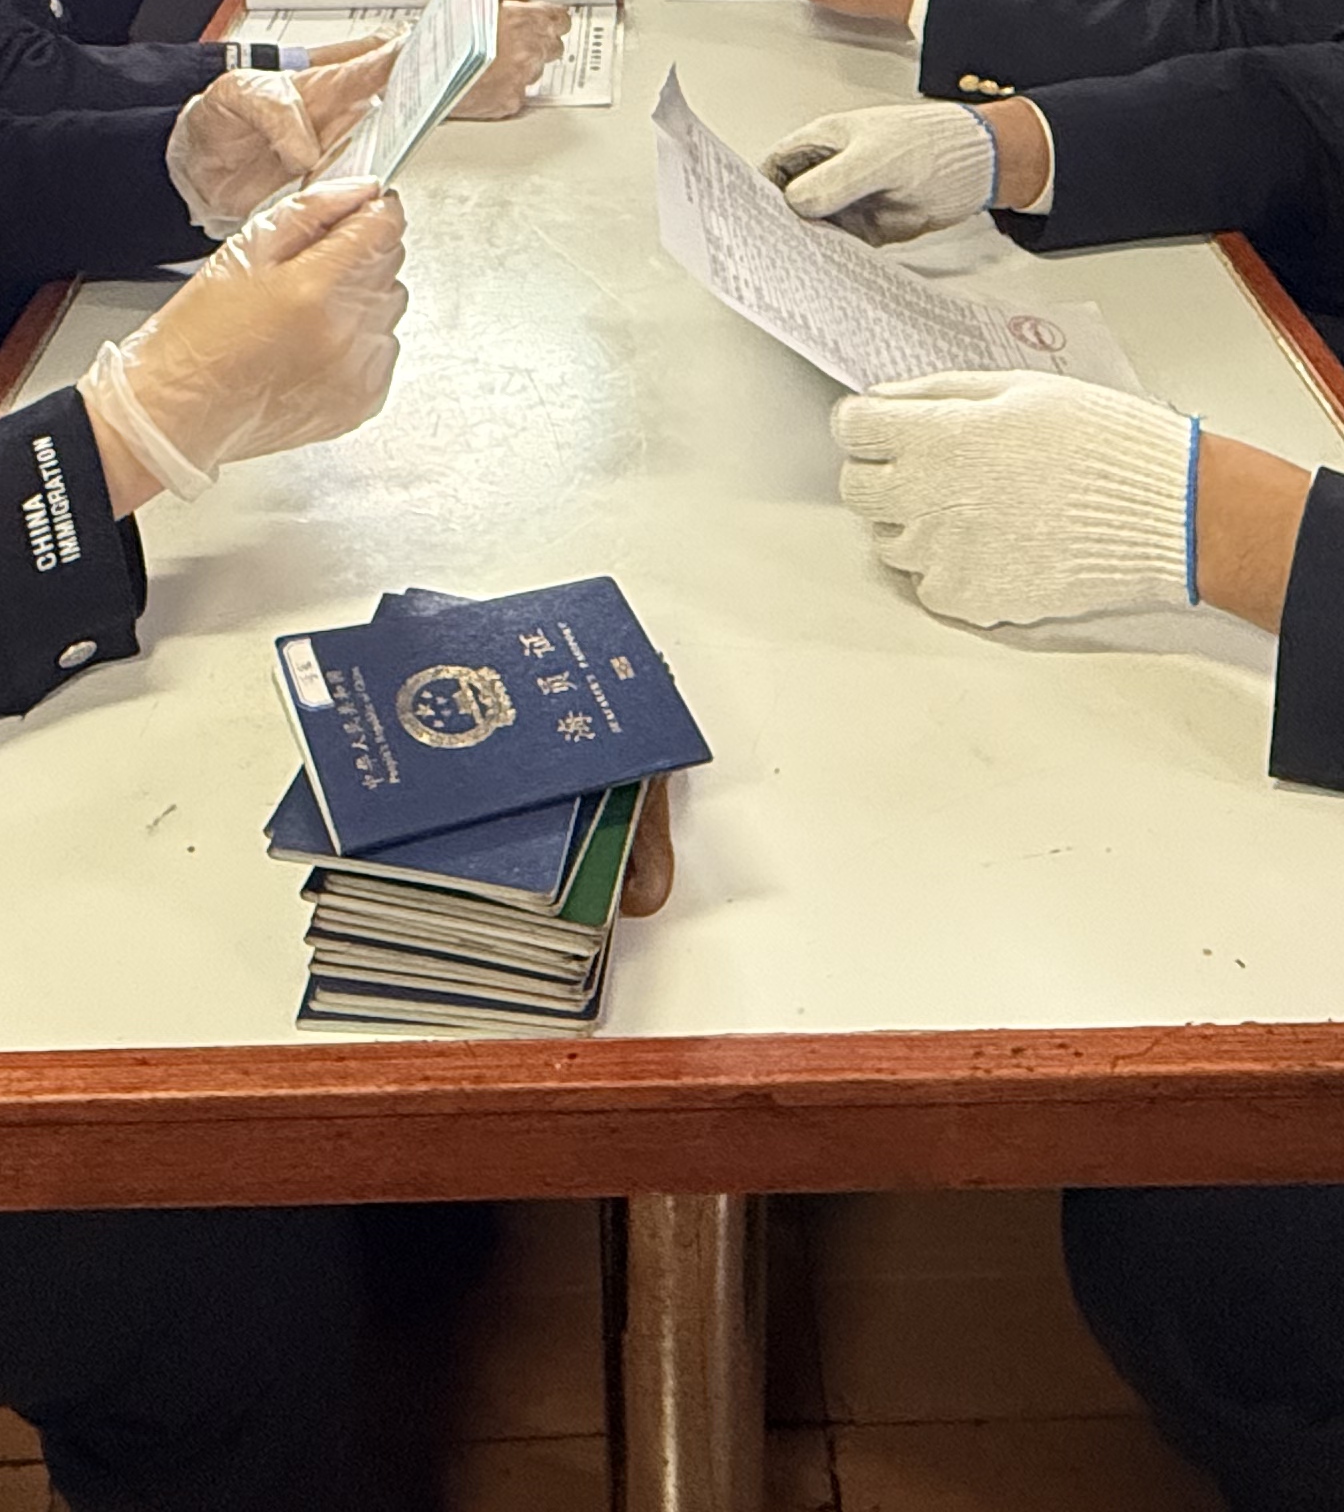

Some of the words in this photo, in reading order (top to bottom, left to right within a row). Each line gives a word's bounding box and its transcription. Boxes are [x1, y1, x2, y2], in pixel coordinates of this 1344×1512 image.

[22, 492, 57, 572] CHINA
[32, 435, 82, 564] IMMIGRATION
[518, 627, 596, 743] 海员证
